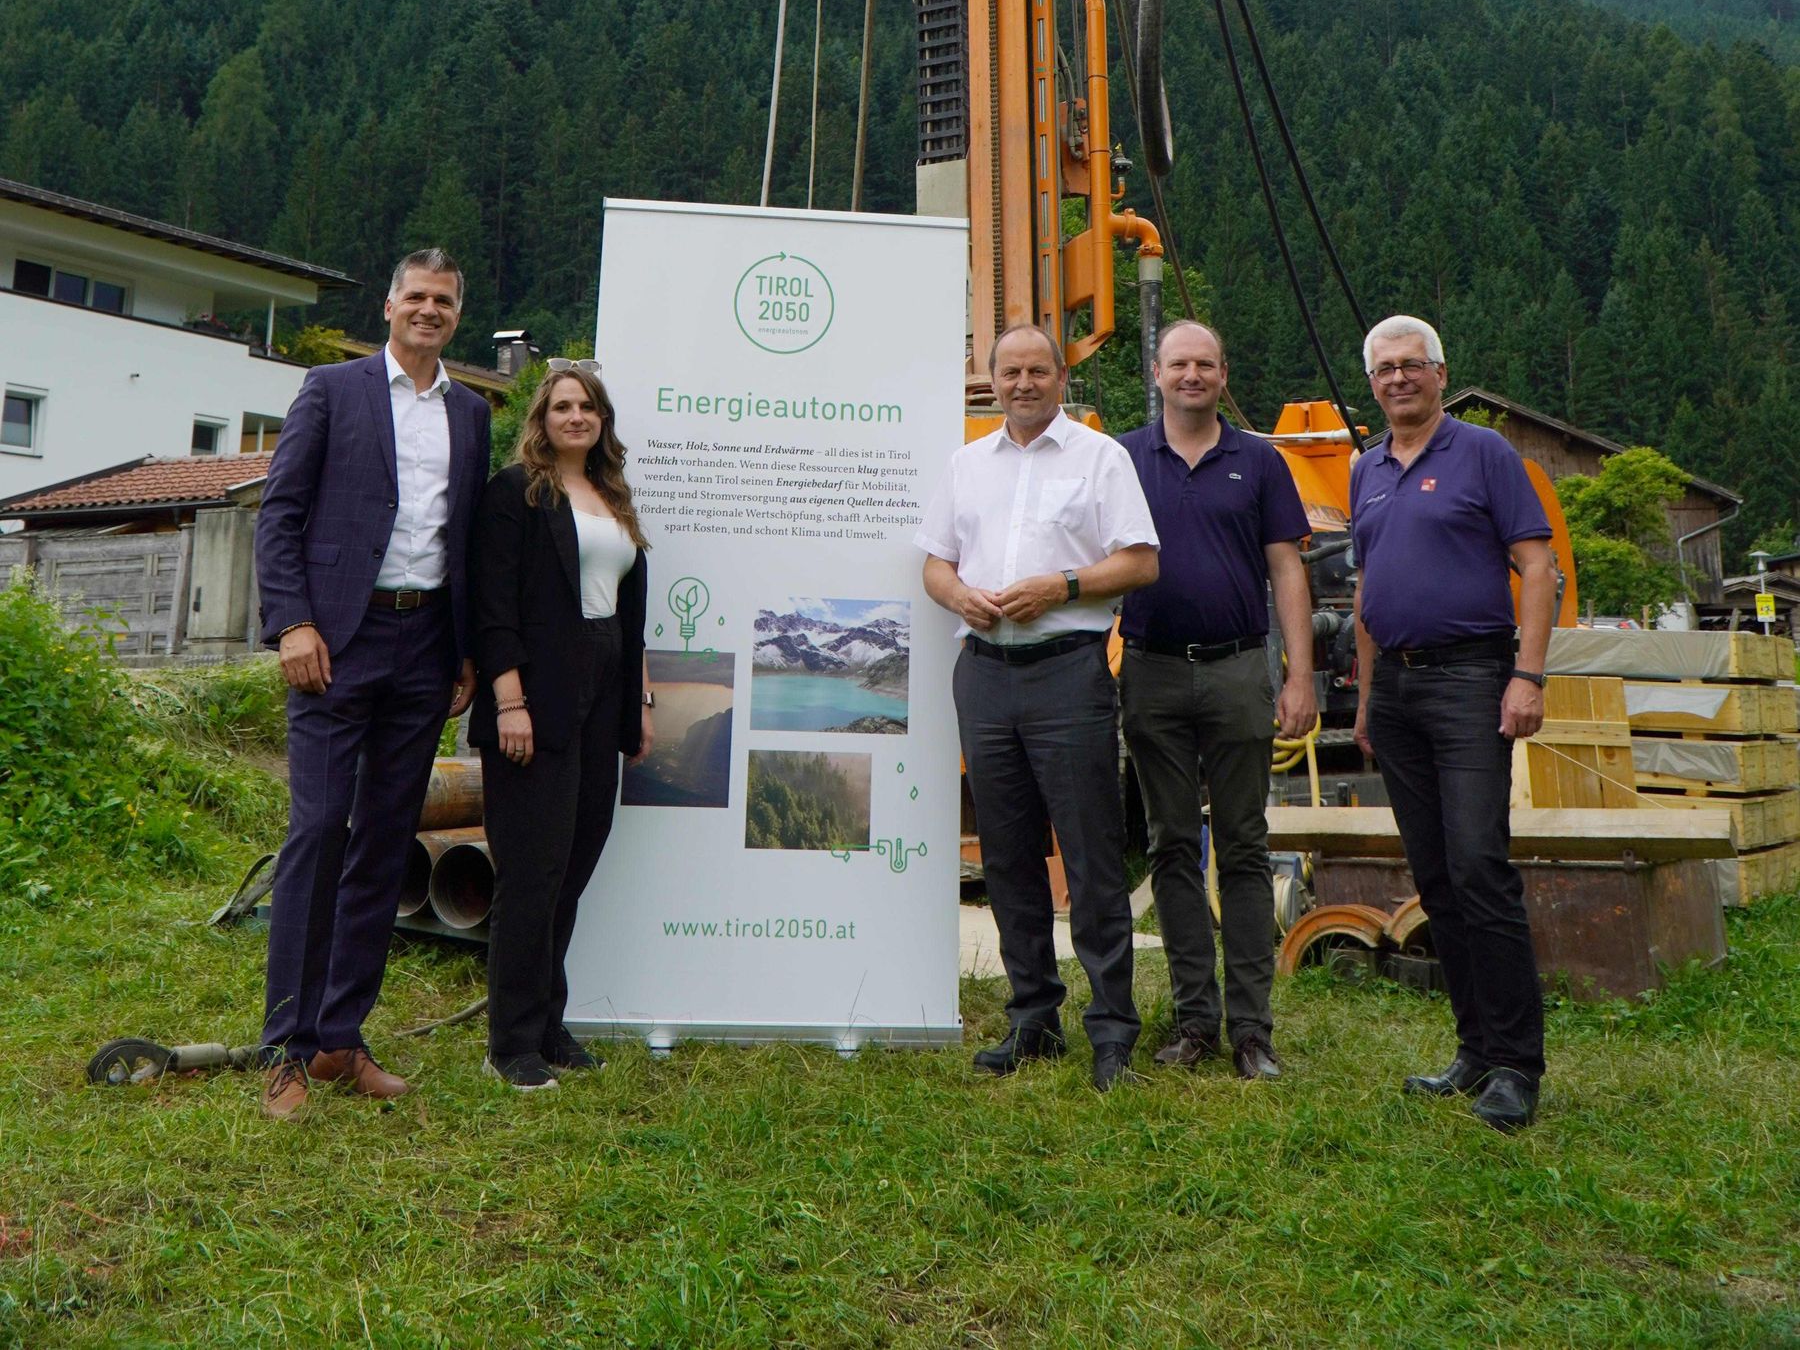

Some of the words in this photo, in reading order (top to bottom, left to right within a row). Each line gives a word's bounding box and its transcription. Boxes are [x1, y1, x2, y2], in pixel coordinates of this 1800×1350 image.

[755, 275, 814, 298] TIROL
[758, 300, 810, 322] 2050
[657, 387, 902, 423] Energieautonom
[648, 440, 683, 450] Wasser,
[686, 442, 710, 452] Holz,
[712, 443, 740, 452] Sonne
[744, 444, 761, 453] und
[765, 445, 814, 456] Erdwärme
[824, 448, 837, 457] all
[839, 448, 858, 458] dies
[862, 449, 873, 458] ist
[876, 450, 885, 458] in
[888, 450, 910, 460] Tirol
[638, 456, 678, 465] reichlich
[680, 458, 737, 469] vorhanden.
[740, 460, 768, 469] Wenn
[771, 462, 796, 471] diese
[800, 463, 855, 473] Ressourcen
[857, 465, 878, 477] klug
[880, 468, 917, 477] genutzt
[644, 472, 684, 483] werden,
[687, 474, 712, 483] kann
[715, 475, 738, 485] Tirol
[741, 477, 773, 486] seinen
[776, 478, 844, 491] Energiebedarf
[845, 480, 859, 489] für
[862, 482, 910, 492] Mobilität,
[633, 488, 675, 500] Heizung
[678, 490, 697, 499] und
[700, 491, 787, 505] Stromversorgung
[809, 495, 844, 506] eigenen
[847, 497, 883, 508] Quellen
[885, 499, 920, 508] decken.
[641, 504, 676, 514] fördert
[678, 505, 694, 515] die
[696, 507, 743, 517] regionale
[746, 509, 825, 523] Wertschöpfung,
[828, 511, 860, 521] schafft
[863, 514, 923, 525] Arbeitsplätz
[664, 523, 690, 532] spart
[694, 523, 730, 534] Kosten,
[733, 525, 752, 534] und
[755, 526, 788, 536] schont
[791, 527, 820, 537] Klima
[824, 528, 842, 538] und
[846, 530, 887, 539] Umwelt.
[663, 919, 855, 939] www.tirol2050.at
